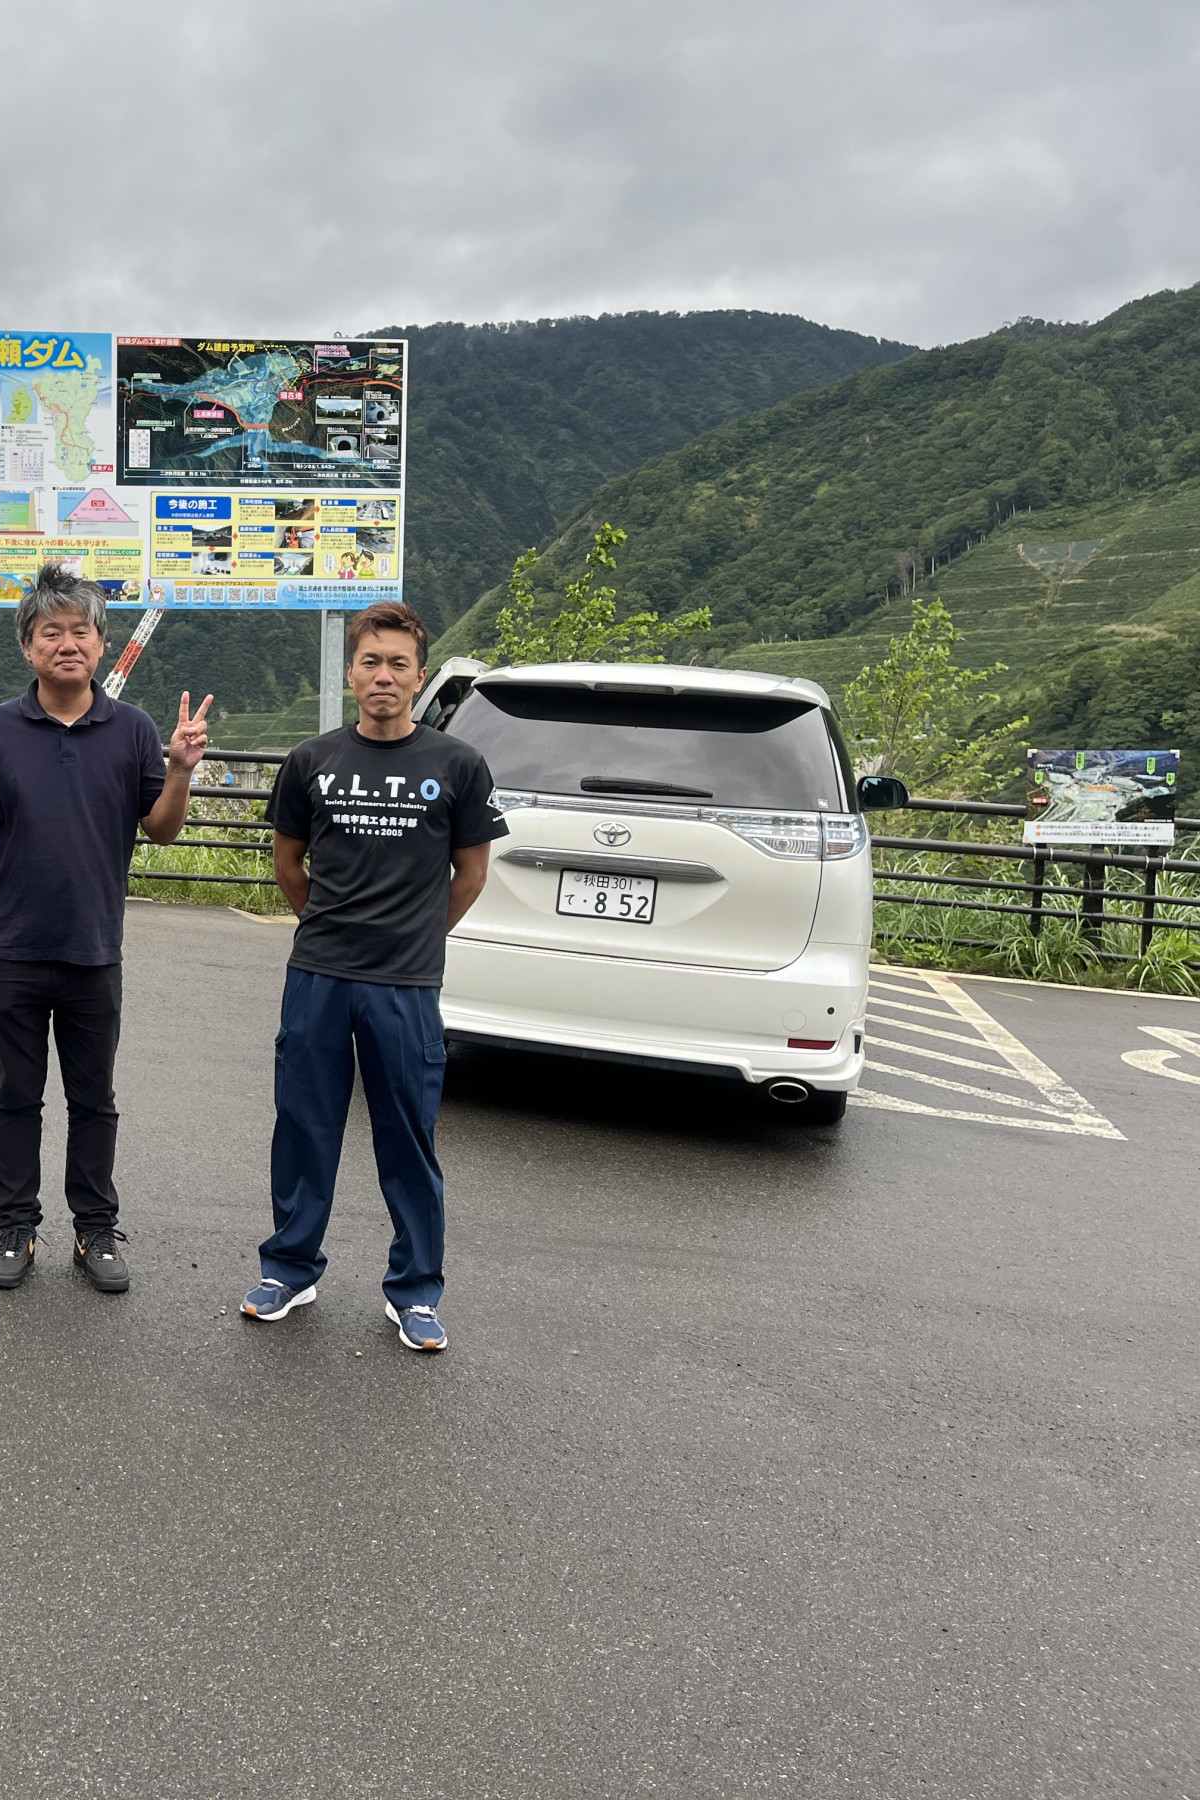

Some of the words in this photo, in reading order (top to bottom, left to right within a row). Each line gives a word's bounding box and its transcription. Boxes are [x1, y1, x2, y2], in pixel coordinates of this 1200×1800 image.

[197, 343, 255, 352] ダム建設予定地
[280, 392, 303, 400] 現在地
[168, 499, 218, 510] 今後の施工
[324, 799, 347, 807] Society
[356, 800, 386, 808] Commerce
[400, 802, 428, 812] Industry
[564, 894, 575, 905] て
